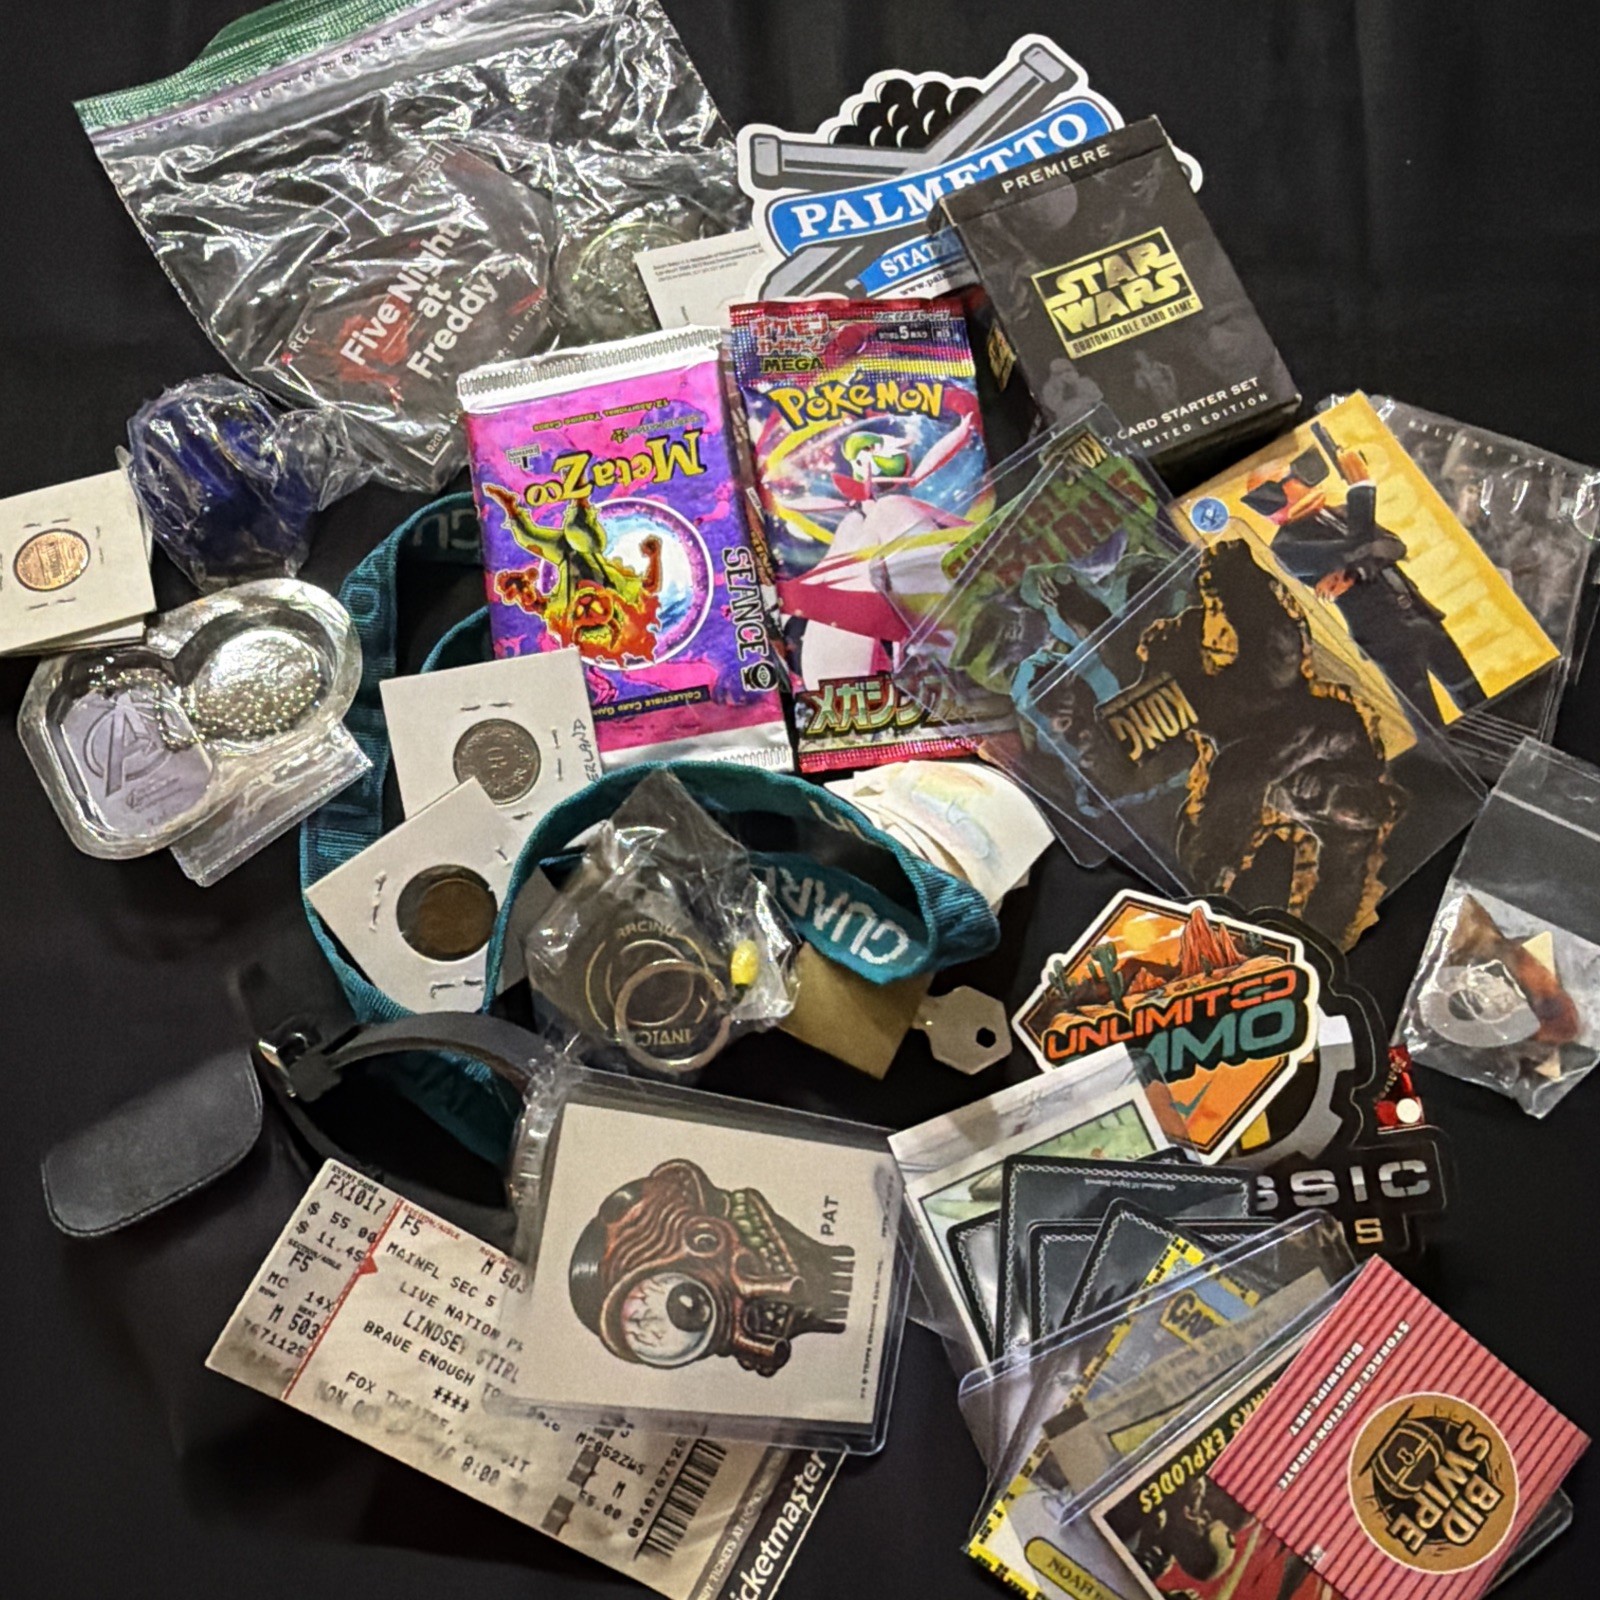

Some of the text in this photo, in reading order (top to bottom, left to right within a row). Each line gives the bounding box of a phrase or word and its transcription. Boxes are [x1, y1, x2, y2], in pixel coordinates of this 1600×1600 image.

[1002, 144, 1110, 193] PREMIERE
[340, 214, 470, 365] Five Night
[879, 243, 938, 279] STAT
[1047, 241, 1178, 305] STAR
[406, 270, 500, 379] Freddy
[417, 282, 451, 319] at
[1052, 267, 1188, 334] WARS
[1072, 297, 1194, 354] CUSTOMIZABLE CARD GAME
[288, 323, 316, 353] REC
[761, 357, 825, 373] MEGA
[655, 398, 669, 407] 12
[1116, 414, 1159, 444] CARD
[1159, 383, 1228, 429] STARTER
[1229, 374, 1260, 397] SET
[1200, 386, 1268, 430] EDITION
[723, 547, 768, 661] SEANCE
[644, 690, 700, 706] COLLECTIBLE
[1110, 681, 1201, 759] KONG
[570, 718, 601, 784] ERLAND
[1047, 968, 1297, 1060] UNLIMITED
[307, 1201, 320, 1216] $
[326, 1174, 387, 1213] FX1017
[820, 1195, 840, 1237] PAT
[295, 1221, 309, 1235] $
[400, 1214, 423, 1238] F5
[480, 1259, 493, 1276] M
[289, 1251, 314, 1273] F5
[386, 1242, 498, 1308] MAINFL SEC 5
[266, 1271, 335, 1313] MC 14X
[399, 1282, 502, 1341] LIVE NATION
[268, 1304, 321, 1340] M 503
[1359, 1319, 1411, 1383] STORAGE
[346, 1371, 377, 1394] FOX
[363, 1320, 412, 1353] BRAVE
[418, 1350, 475, 1386] ENOUGH
[1287, 1339, 1364, 1438] BIDSWIPE.NET
[1314, 1379, 1363, 1441] AUCTION
[612, 1480, 626, 1498] M
[1138, 1429, 1227, 1515] EXPLODES
[1276, 1437, 1318, 1490] PIRATE
[1387, 1420, 1494, 1557] SWIPE
[730, 1450, 828, 1600] icketmaster
[1439, 1474, 1506, 1552] BID
